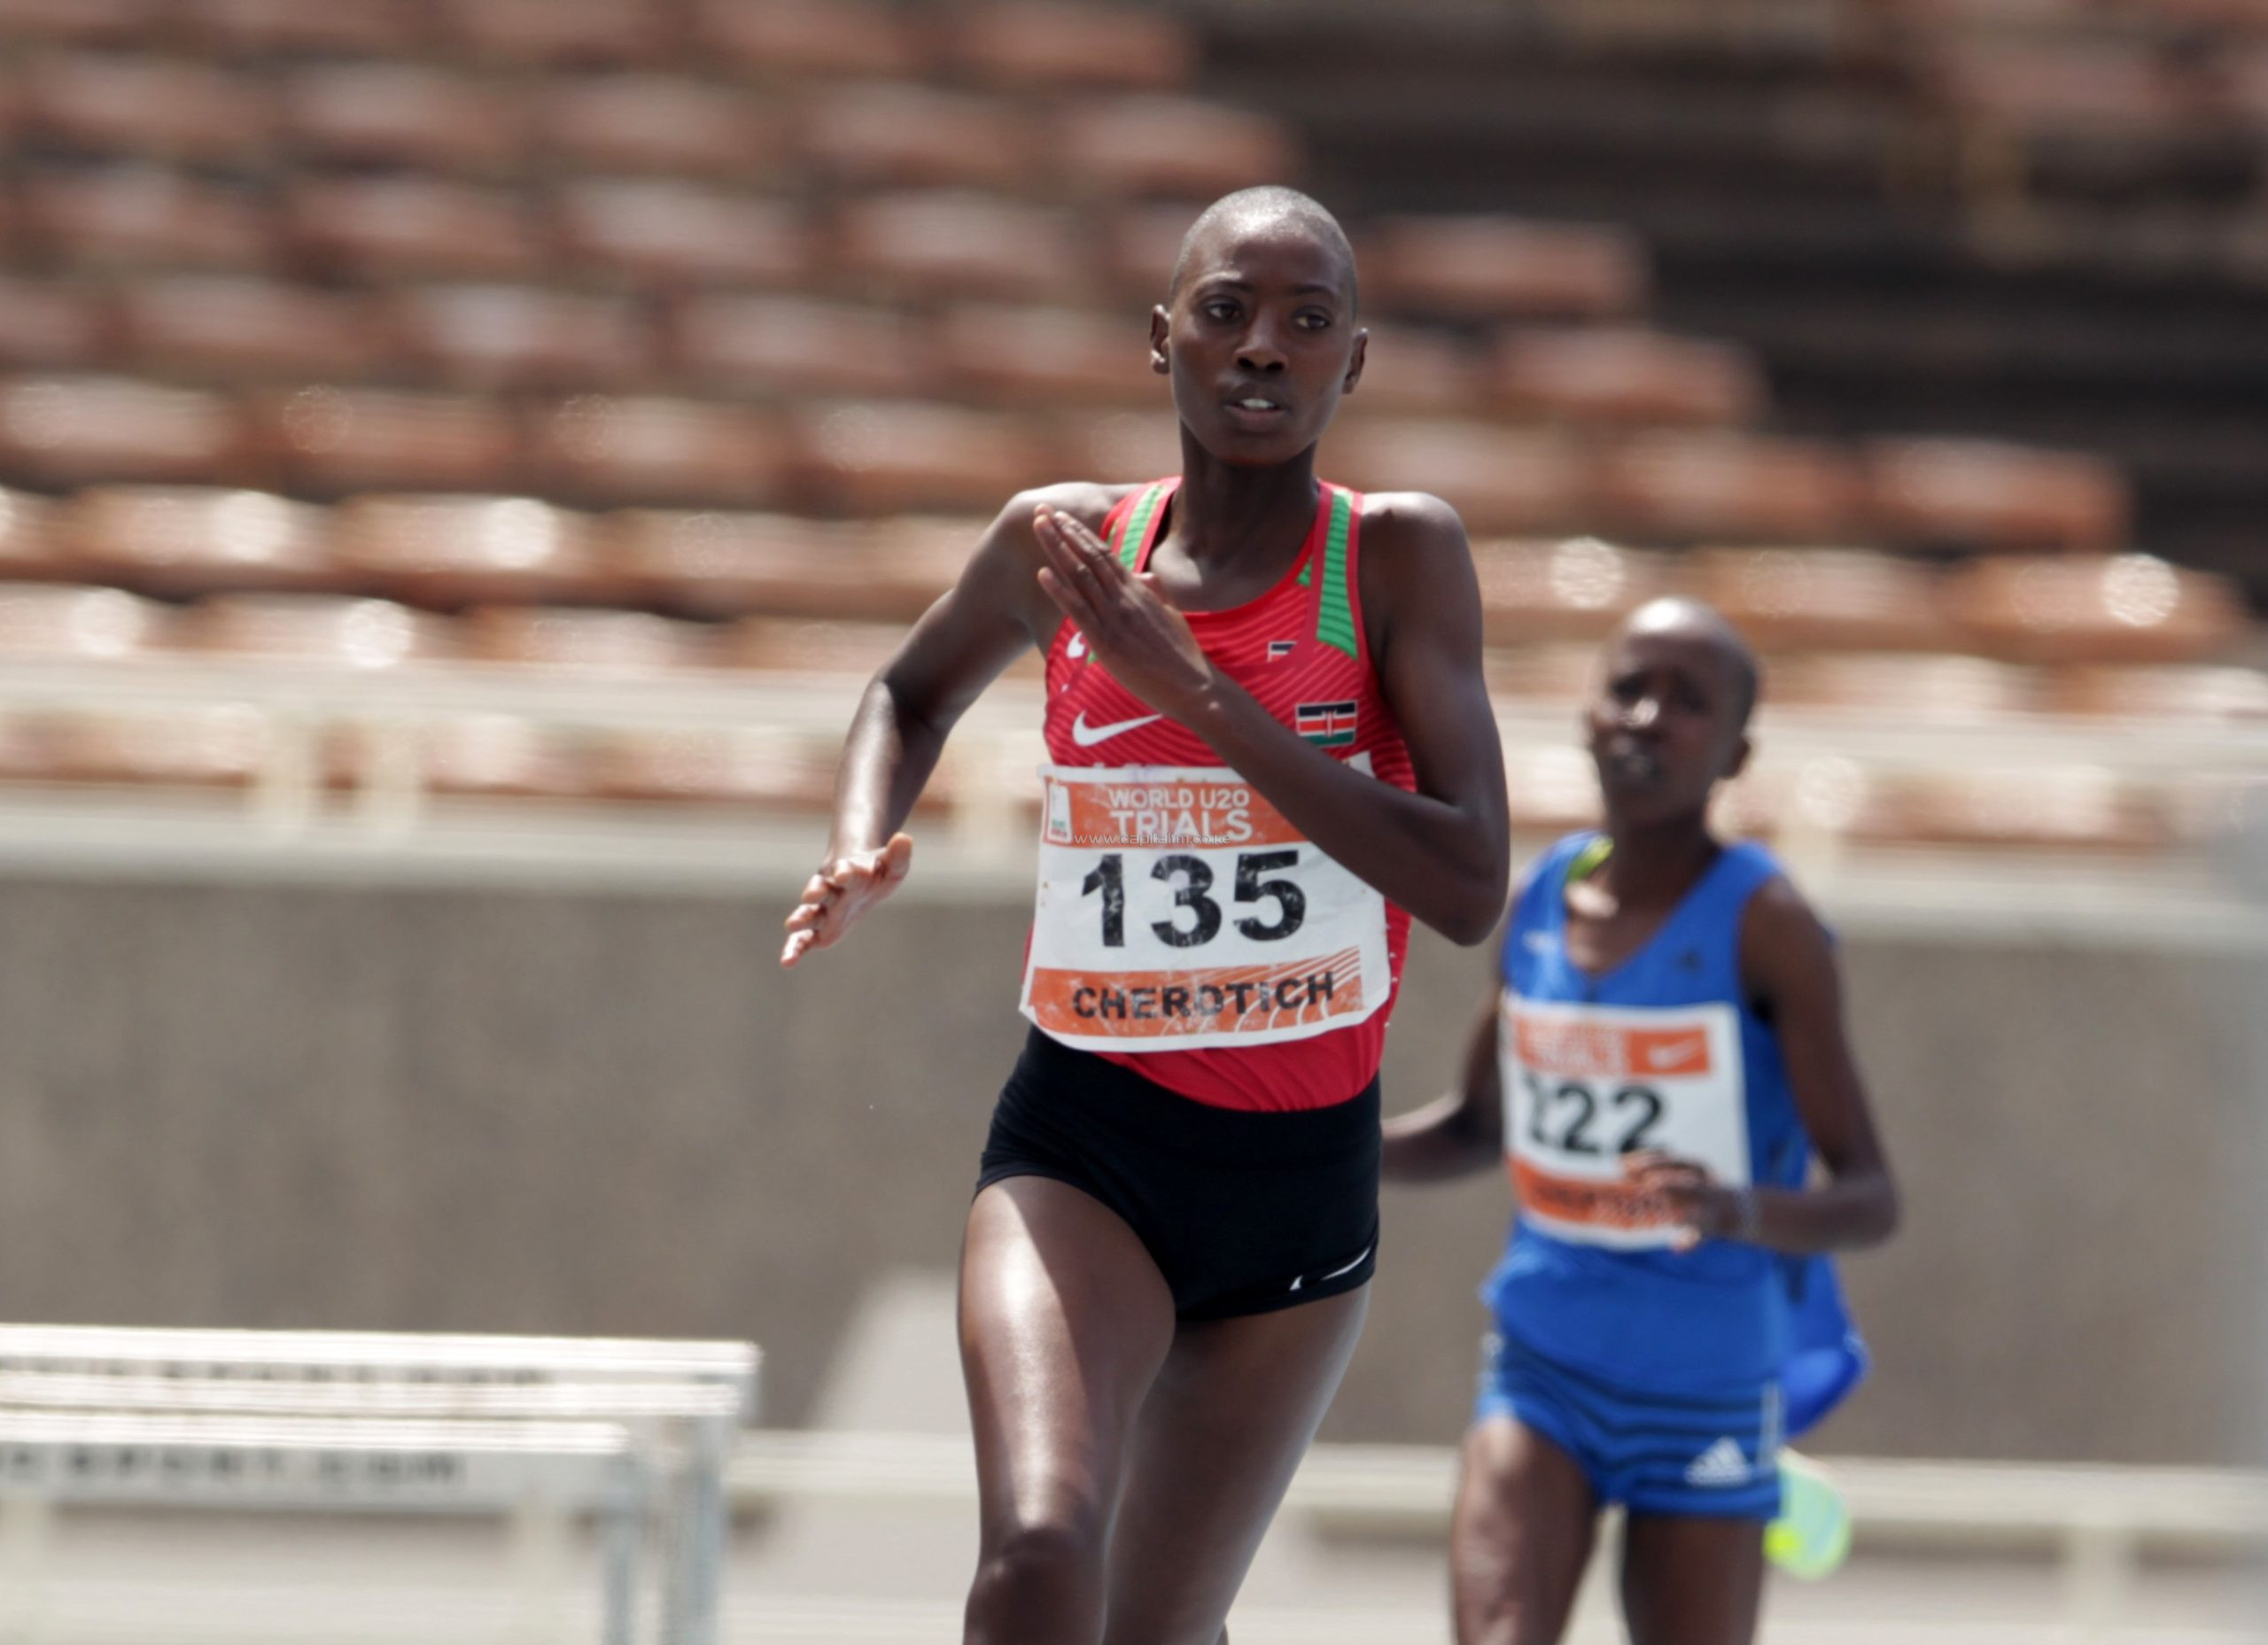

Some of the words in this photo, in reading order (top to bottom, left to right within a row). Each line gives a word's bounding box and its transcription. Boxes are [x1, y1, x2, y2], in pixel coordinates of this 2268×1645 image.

[1108, 788, 1193, 810] WORLD
[1199, 788, 1250, 810] U20
[1109, 808, 1254, 842] TRIALS
[1082, 850, 1306, 948] 135
[1072, 972, 1334, 1020] CHEROTICH
